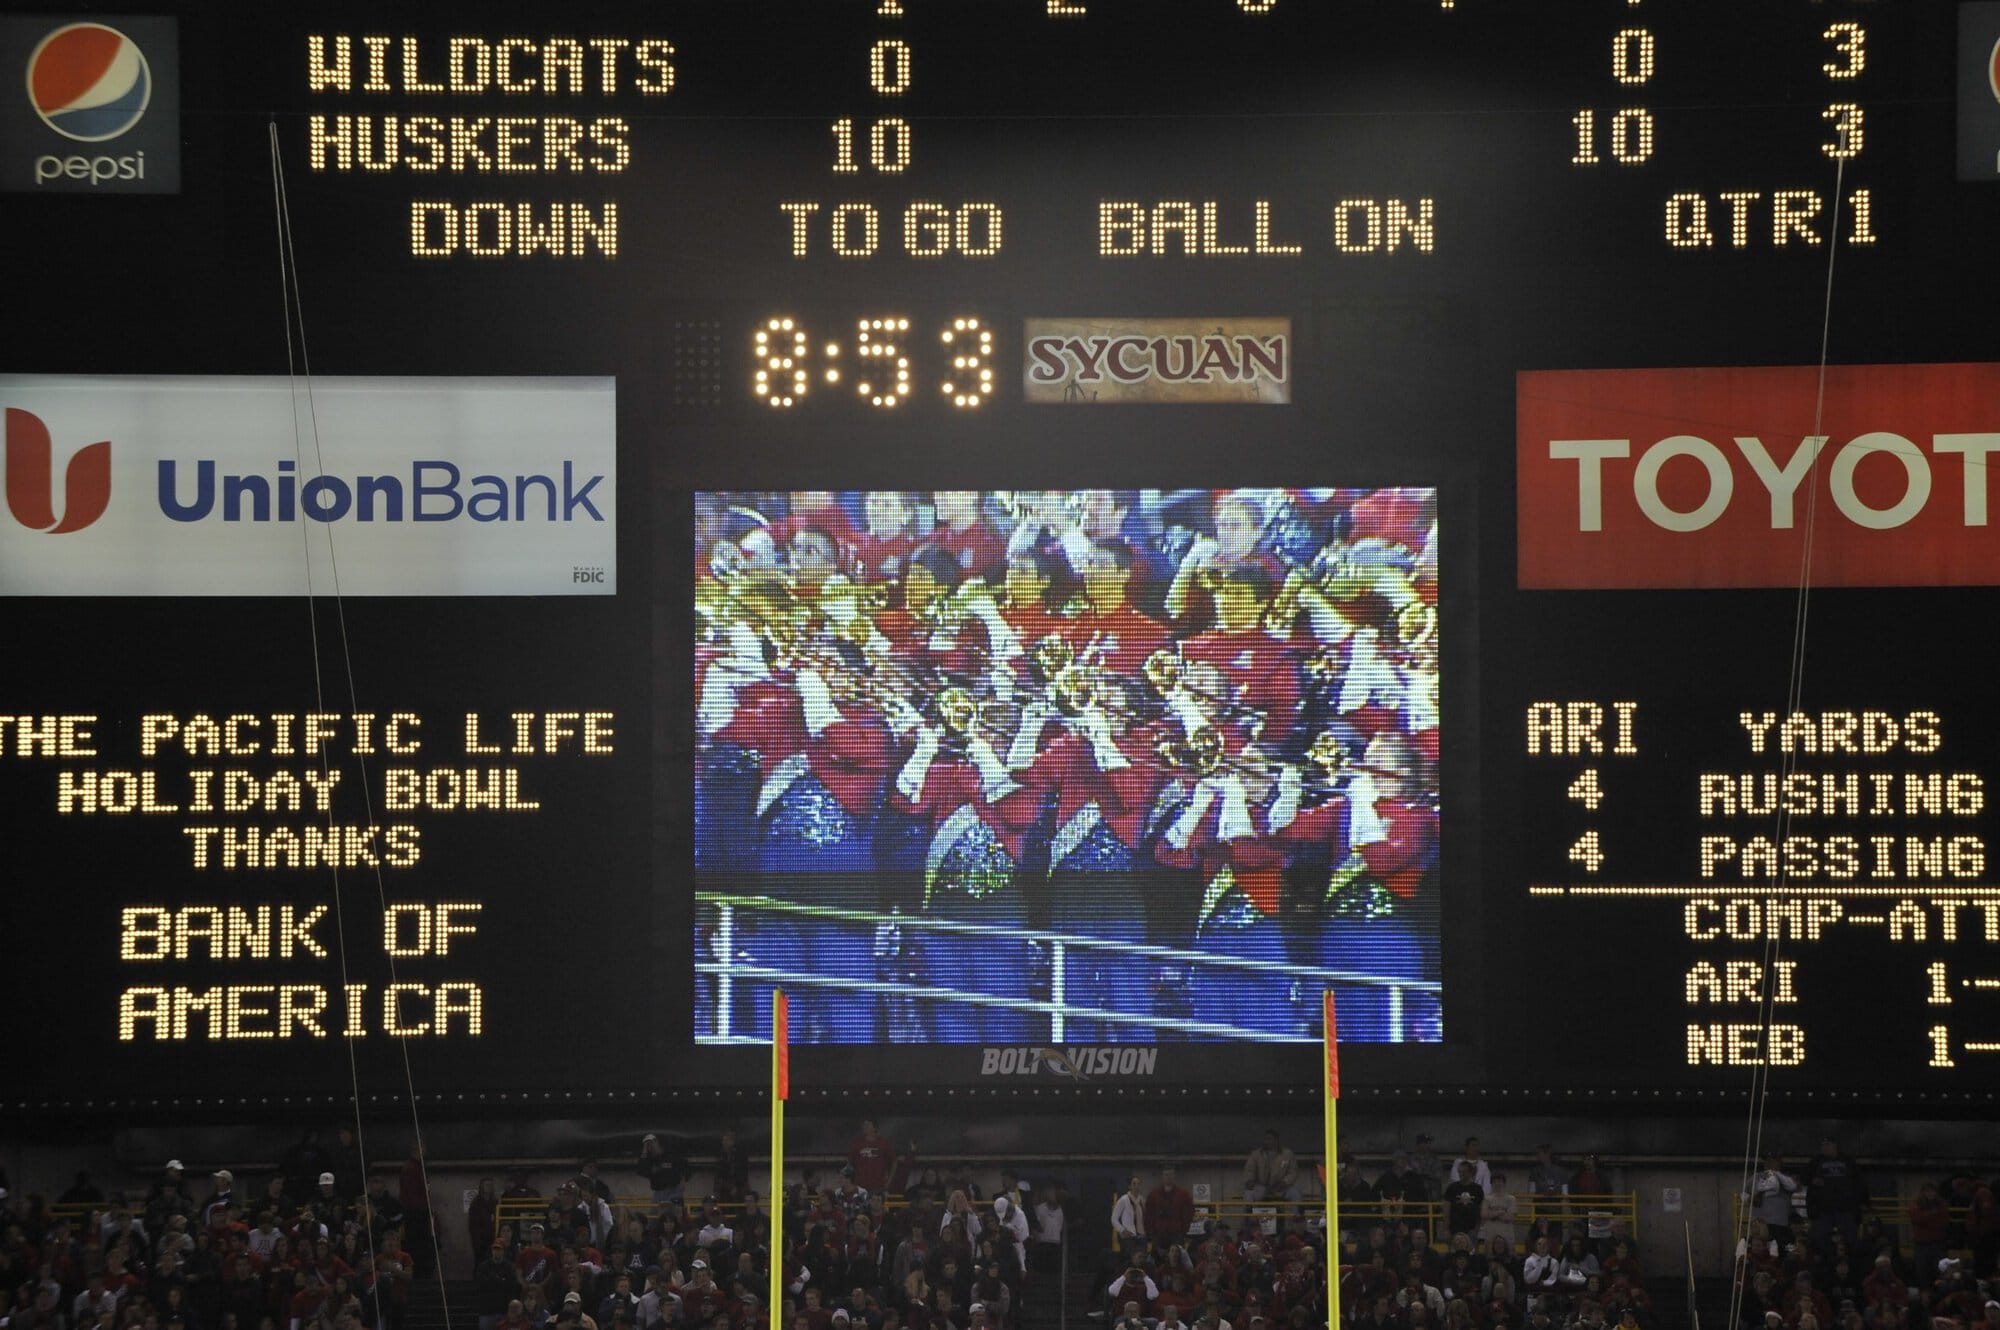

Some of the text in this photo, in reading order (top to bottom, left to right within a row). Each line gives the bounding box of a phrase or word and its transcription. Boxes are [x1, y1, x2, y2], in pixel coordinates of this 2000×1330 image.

[308, 22, 1866, 93] WILDCATS 0 0 3
[309, 103, 1864, 172] HUSKERS 10 10 3
[35, 150, 145, 186] pepsi
[411, 202, 618, 256] DOWN
[780, 202, 1002, 256] TO GO
[1099, 198, 1433, 255] BALL ON
[1664, 189, 1877, 247] QTR 1
[755, 317, 992, 407] 8:53
[1029, 335, 1287, 384] SYCUAN
[157, 459, 606, 523] UnionBank
[1549, 432, 2000, 532] TOYOT
[573, 571, 604, 583] FDIC
[141, 713, 421, 755] PACIFIC
[465, 712, 614, 753] LIFE
[1527, 702, 1941, 754] ARI YARDS
[57, 768, 540, 813] HOLIDAY BOWL
[1568, 768, 1984, 815] 4 RUSHING
[183, 825, 420, 868] THANKS
[1568, 831, 1985, 877] 4 PASSING
[120, 903, 483, 960] BANK OF
[1684, 898, 2000, 940] COMP-ATT
[1685, 961, 1798, 1003] ARI
[119, 982, 483, 1040] AMERICA
[981, 1048, 1158, 1075] BOLT VISION
[1686, 1024, 1805, 1066] NEB
